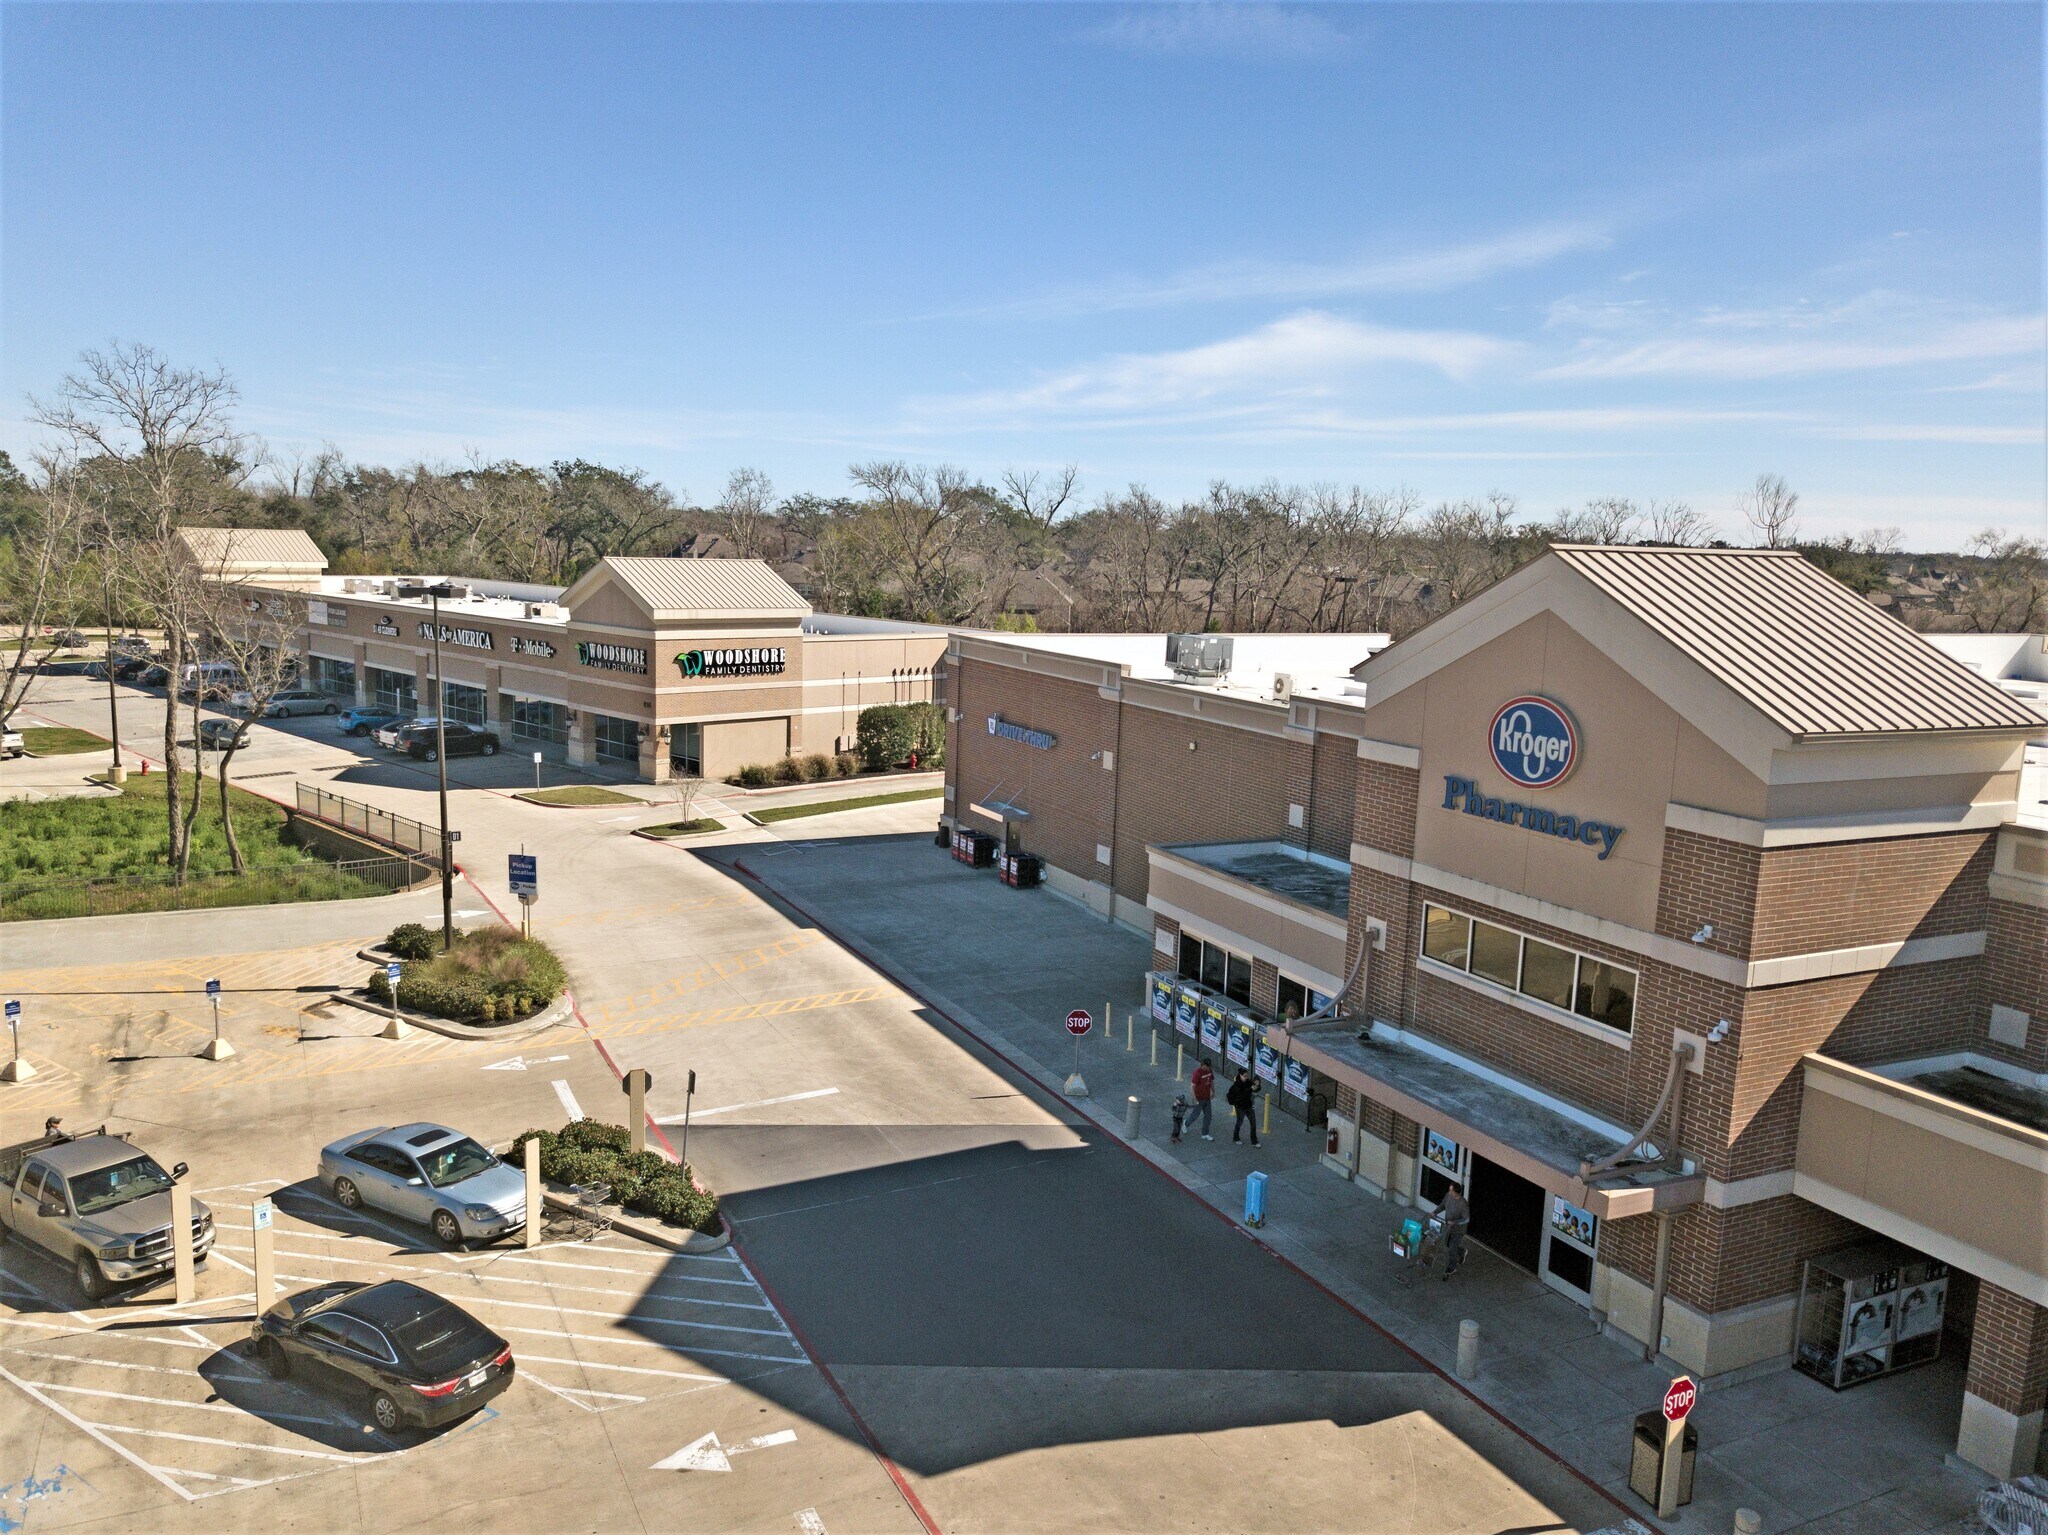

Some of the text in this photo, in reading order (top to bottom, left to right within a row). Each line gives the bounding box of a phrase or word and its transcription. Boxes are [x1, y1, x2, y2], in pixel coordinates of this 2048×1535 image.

[452, 629, 492, 650] AMERICA
[589, 643, 645, 665] WOODSHORE
[704, 647, 786, 666] WOODSHORE
[612, 662, 646, 675] DENTISTRY
[705, 664, 786, 675] FAMILY DENTISTRY
[1499, 710, 1569, 778] Kroger
[1441, 776, 1623, 860] Pharmacy
[1067, 1017, 1090, 1028] STOP
[1666, 1390, 1693, 1411] STOP
